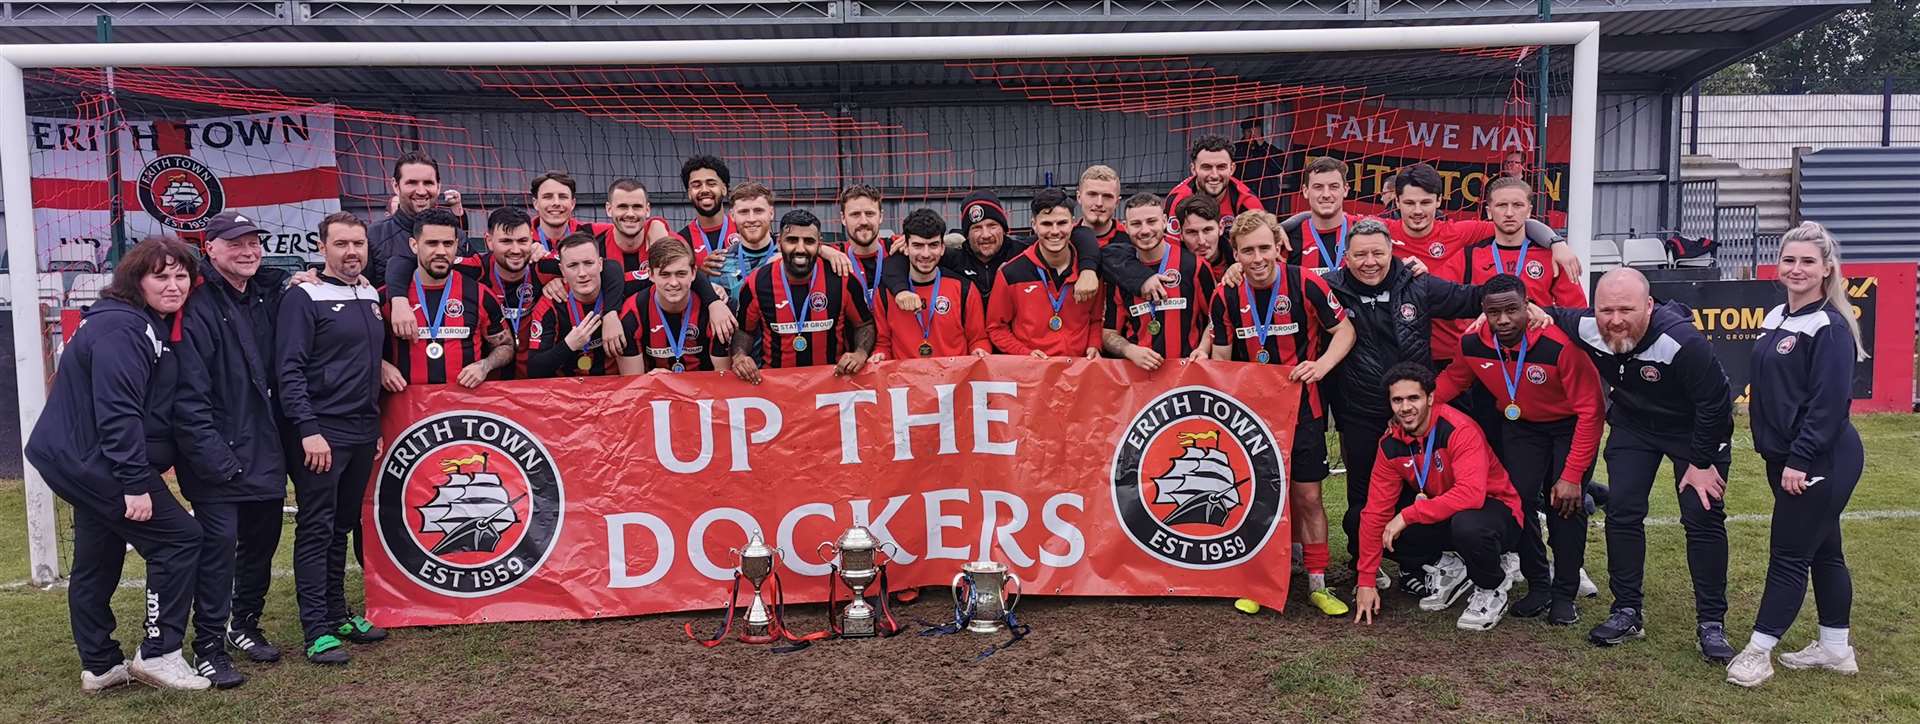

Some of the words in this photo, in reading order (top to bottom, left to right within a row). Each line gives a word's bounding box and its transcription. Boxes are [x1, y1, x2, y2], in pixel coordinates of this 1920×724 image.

[175, 114, 311, 149] TOWN
[1326, 113, 1394, 145] FAIL
[1406, 120, 1460, 149] WE
[174, 158, 212, 182] TOWN
[1437, 170, 1562, 202] TON
[164, 217, 185, 229] EST
[444, 327, 469, 335] GROUP
[780, 323, 809, 331] STATM
[1692, 306, 1764, 331] ATOM
[649, 396, 783, 474] UP
[815, 380, 1019, 465] THE
[1127, 394, 1192, 451] ERITH
[1199, 394, 1269, 457] TOWN
[386, 420, 454, 481] ERITH
[461, 418, 544, 473] TOWN
[603, 488, 1087, 589] DOCKERS
[1148, 529, 1194, 559] EST
[1199, 535, 1247, 561] 1959
[418, 559, 465, 588] EST
[470, 557, 524, 588] 1959
